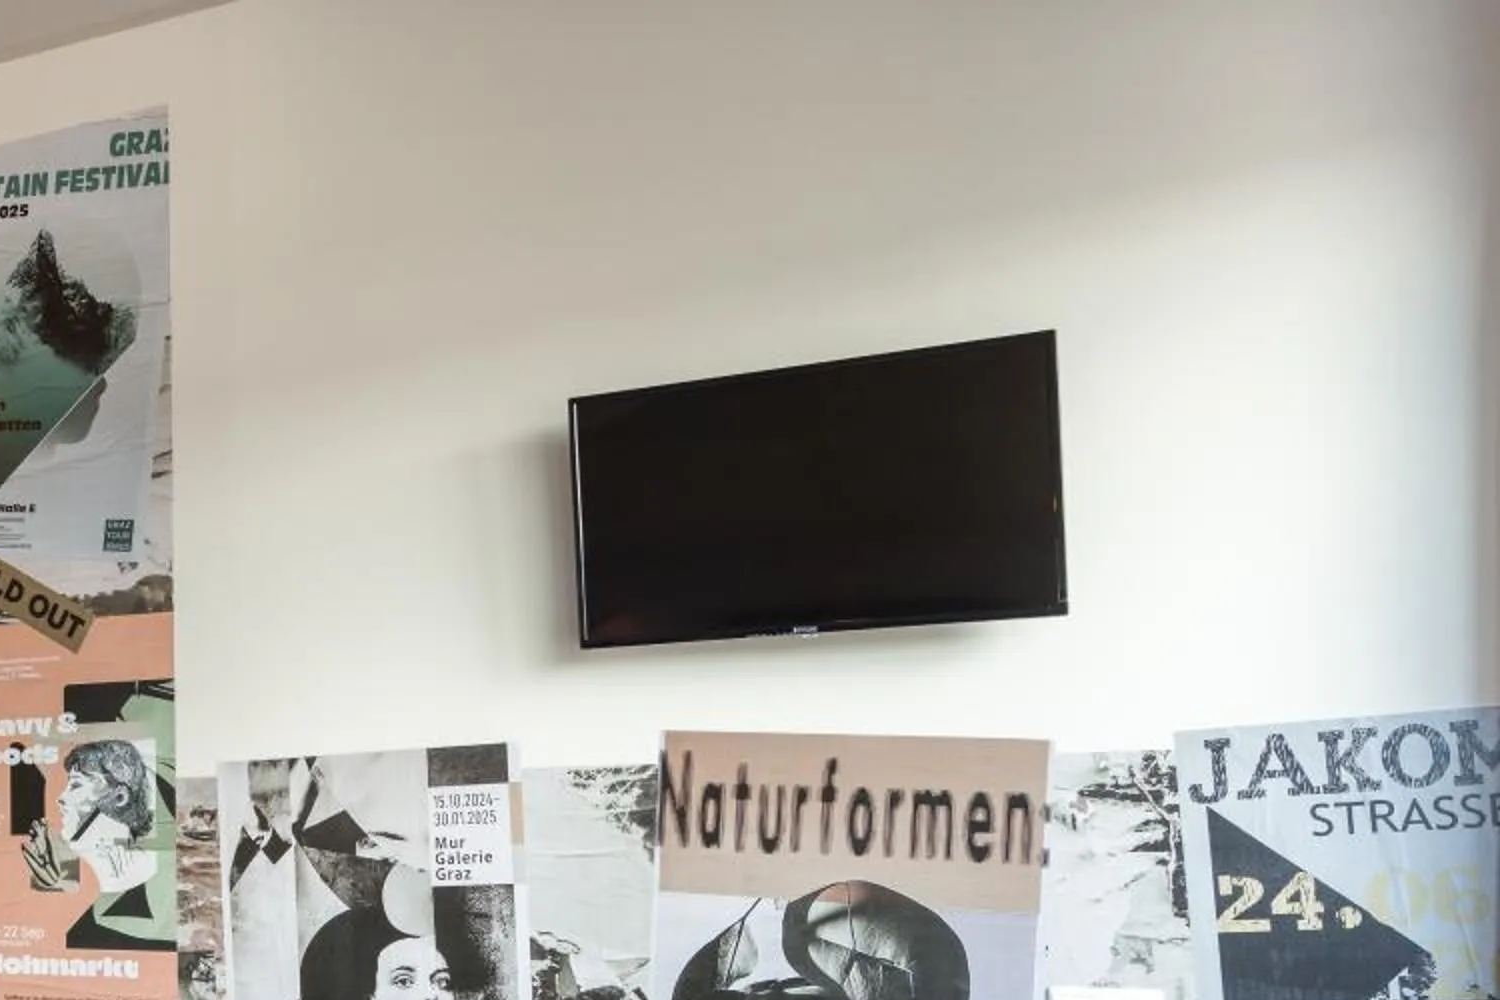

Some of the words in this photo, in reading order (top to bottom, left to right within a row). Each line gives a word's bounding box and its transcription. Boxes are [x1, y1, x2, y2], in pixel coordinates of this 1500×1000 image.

[27, 593, 86, 639] OUT
[57, 711, 78, 733] &
[433, 793, 501, 809] 15.10.2024-
[434, 809, 497, 827] 30.01.2025
[435, 836, 465, 849] Mur
[435, 850, 493, 865] Galerie
[435, 867, 472, 881] Graz
[1215, 870, 1363, 934] 24.
